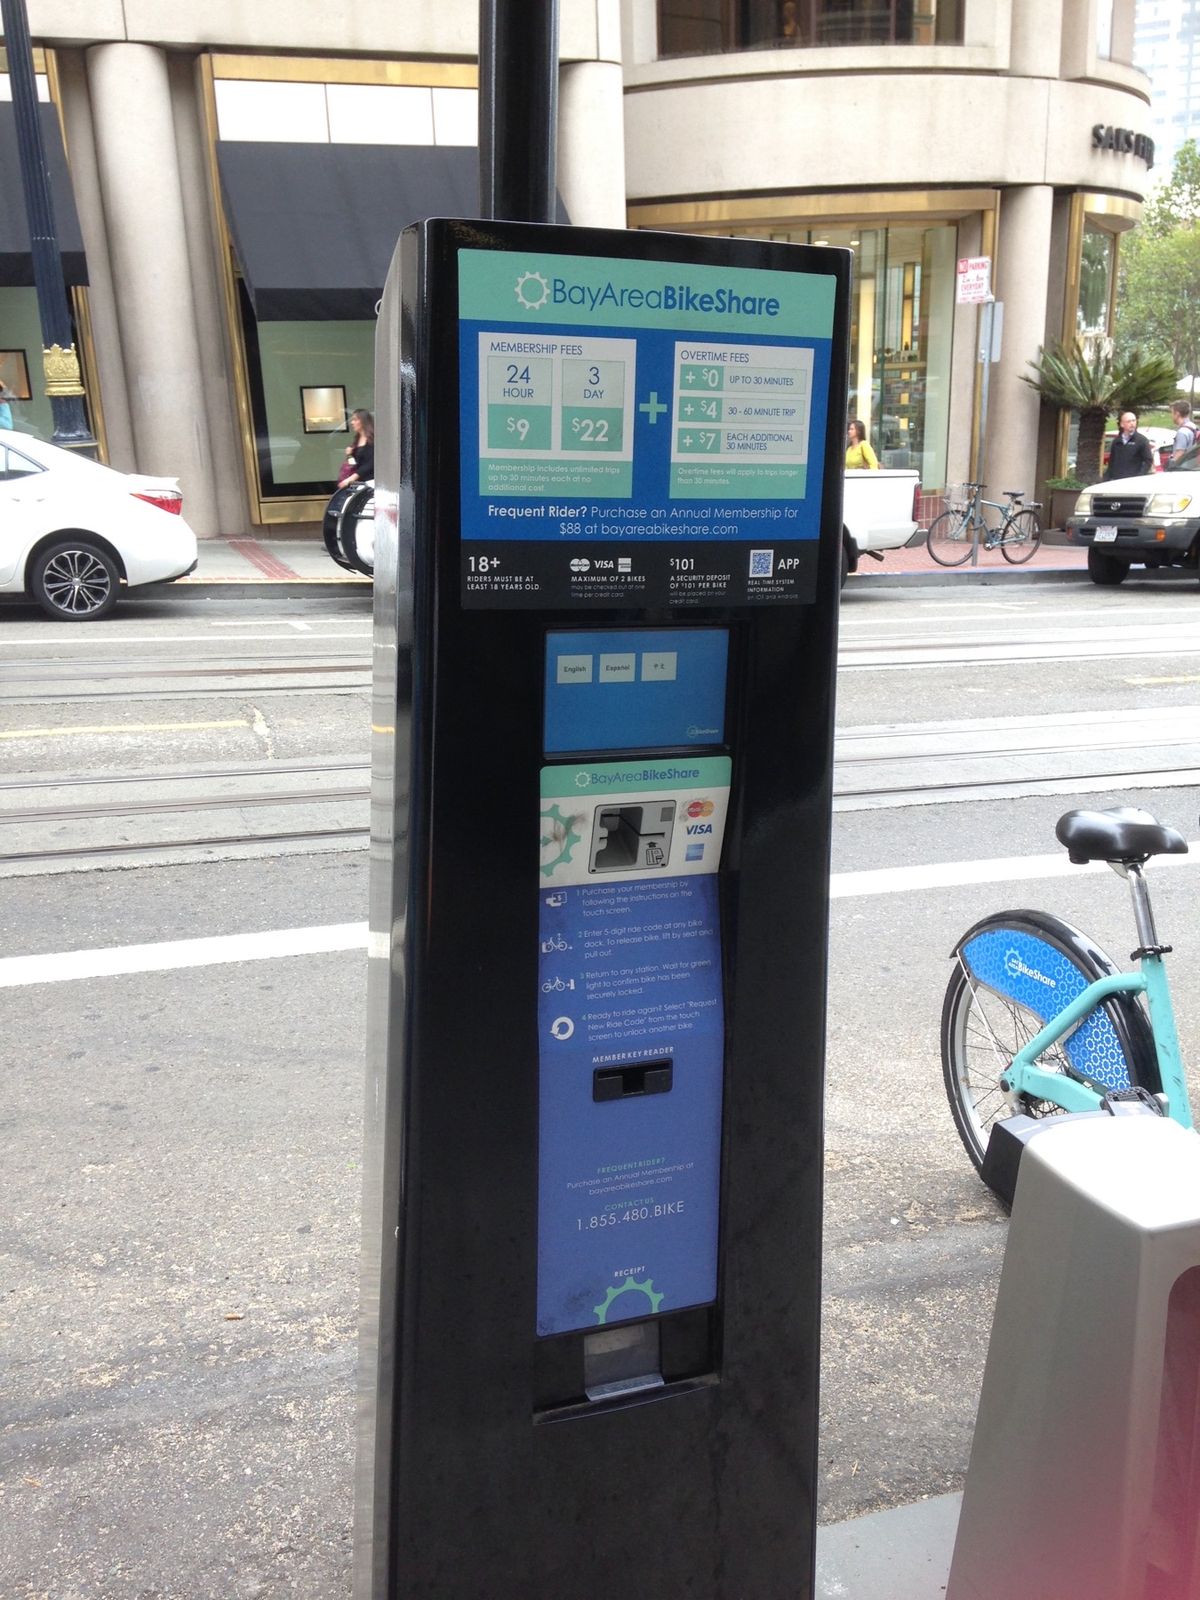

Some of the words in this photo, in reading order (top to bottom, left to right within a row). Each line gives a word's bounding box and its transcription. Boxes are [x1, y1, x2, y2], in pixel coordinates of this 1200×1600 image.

[552, 278, 780, 316] BayAreaBikeShare
[490, 341, 558, 354] MEMBERSHIP
[560, 344, 583, 356] FEES
[680, 350, 727, 362] OVERTIME
[729, 353, 750, 363] FEES
[506, 364, 531, 384] 24
[588, 366, 600, 385] 3
[702, 367, 719, 388] $0
[729, 375, 741, 384] UP
[742, 376, 752, 385] TO
[753, 376, 763, 385] 30
[763, 377, 794, 386] MINUTES
[503, 387, 534, 398] HOUR
[583, 389, 604, 399] DAY
[700, 400, 717, 419] $4
[728, 406, 738, 416] 30
[743, 407, 753, 416] 60
[753, 407, 781, 417] MINUTE
[782, 408, 796, 417] TRIP
[506, 416, 530, 441] $9
[571, 417, 609, 442] $22
[699, 431, 716, 450] $7
[726, 432, 749, 441] EACH
[750, 433, 794, 442] ADDITIONAL
[726, 442, 736, 450] 30
[737, 442, 767, 451] MINUTES
[488, 464, 536, 473] Membership
[537, 464, 568, 472] includes
[570, 465, 604, 473] unlimited
[605, 466, 620, 475] trips
[678, 467, 709, 475] Overtime
[737, 468, 756, 477] apply
[765, 469, 778, 477] trips
[779, 469, 798, 477] longer
[488, 504, 545, 519] Frequent
[549, 505, 588, 518] Rider?
[591, 506, 647, 519] Purchase
[650, 509, 667, 519] an
[669, 507, 711, 519] Annual
[713, 507, 781, 521] Membership
[784, 507, 798, 518] for
[559, 522, 581, 535] $88
[584, 523, 599, 535] at
[601, 523, 739, 537] bayareabikeshare.com
[468, 556, 501, 572] 18+
[594, 560, 614, 569] VISA
[670, 558, 695, 571] $101
[777, 558, 800, 570] APP
[563, 665, 587, 674] English
[605, 664, 630, 672] Español
[591, 768, 700, 785] BayAreaBikeShare
[687, 824, 713, 835] VISA
[582, 887, 616, 896] Purchase
[616, 886, 633, 894] your
[634, 881, 679, 891] membership
[680, 880, 689, 889] by
[582, 897, 615, 907] following
[616, 895, 628, 903] the
[629, 892, 669, 903] instructions
[583, 908, 605, 917] touch
[584, 929, 603, 938] Enter
[604, 927, 627, 936] 5-digit
[627, 926, 642, 934] ride
[643, 924, 663, 932] code
[673, 921, 687, 929] any
[688, 919, 703, 928] bike
[606, 938, 616, 946] To
[616, 936, 643, 945] release
[662, 932, 671, 940] lift
[672, 931, 681, 940] by
[682, 930, 698, 938] seat
[698, 928, 713, 936] and
[584, 951, 598, 959] pull
[586, 970, 610, 979] Return
[611, 969, 619, 977] to
[620, 968, 634, 976] any
[662, 962, 679, 970] Wait
[690, 960, 712, 969] green
[1018, 961, 1056, 989] BikeShare
[586, 981, 602, 991] light
[602, 980, 611, 988] to
[612, 978, 640, 987] confirm
[640, 975, 656, 984] bike
[671, 972, 691, 980] been
[586, 990, 616, 1000] securely
[587, 1012, 612, 1020] Ready
[612, 1010, 621, 1018] to
[663, 1003, 686, 1011] Select
[587, 1023, 605, 1031] New
[606, 1021, 623, 1029] Ride
[679, 1011, 701, 1019] touch
[588, 1032, 613, 1041] screen
[623, 1028, 647, 1037] unlock
[648, 1024, 677, 1033] another
[592, 1053, 626, 1063] MEMBER
[627, 1050, 642, 1059] KEY
[643, 1046, 674, 1056] READER
[597, 1162, 638, 1174] FREQUENT
[639, 1157, 665, 1168] RIDER?
[566, 1178, 601, 1189] Purchase
[614, 1170, 640, 1180] Annual
[641, 1165, 685, 1177] Membership
[588, 1176, 673, 1196] bayareabikeshare.com
[605, 1199, 643, 1211] CONTACT
[577, 1200, 685, 1231] 1.855.480.BIKE
[614, 1265, 646, 1278] RECEIPT
